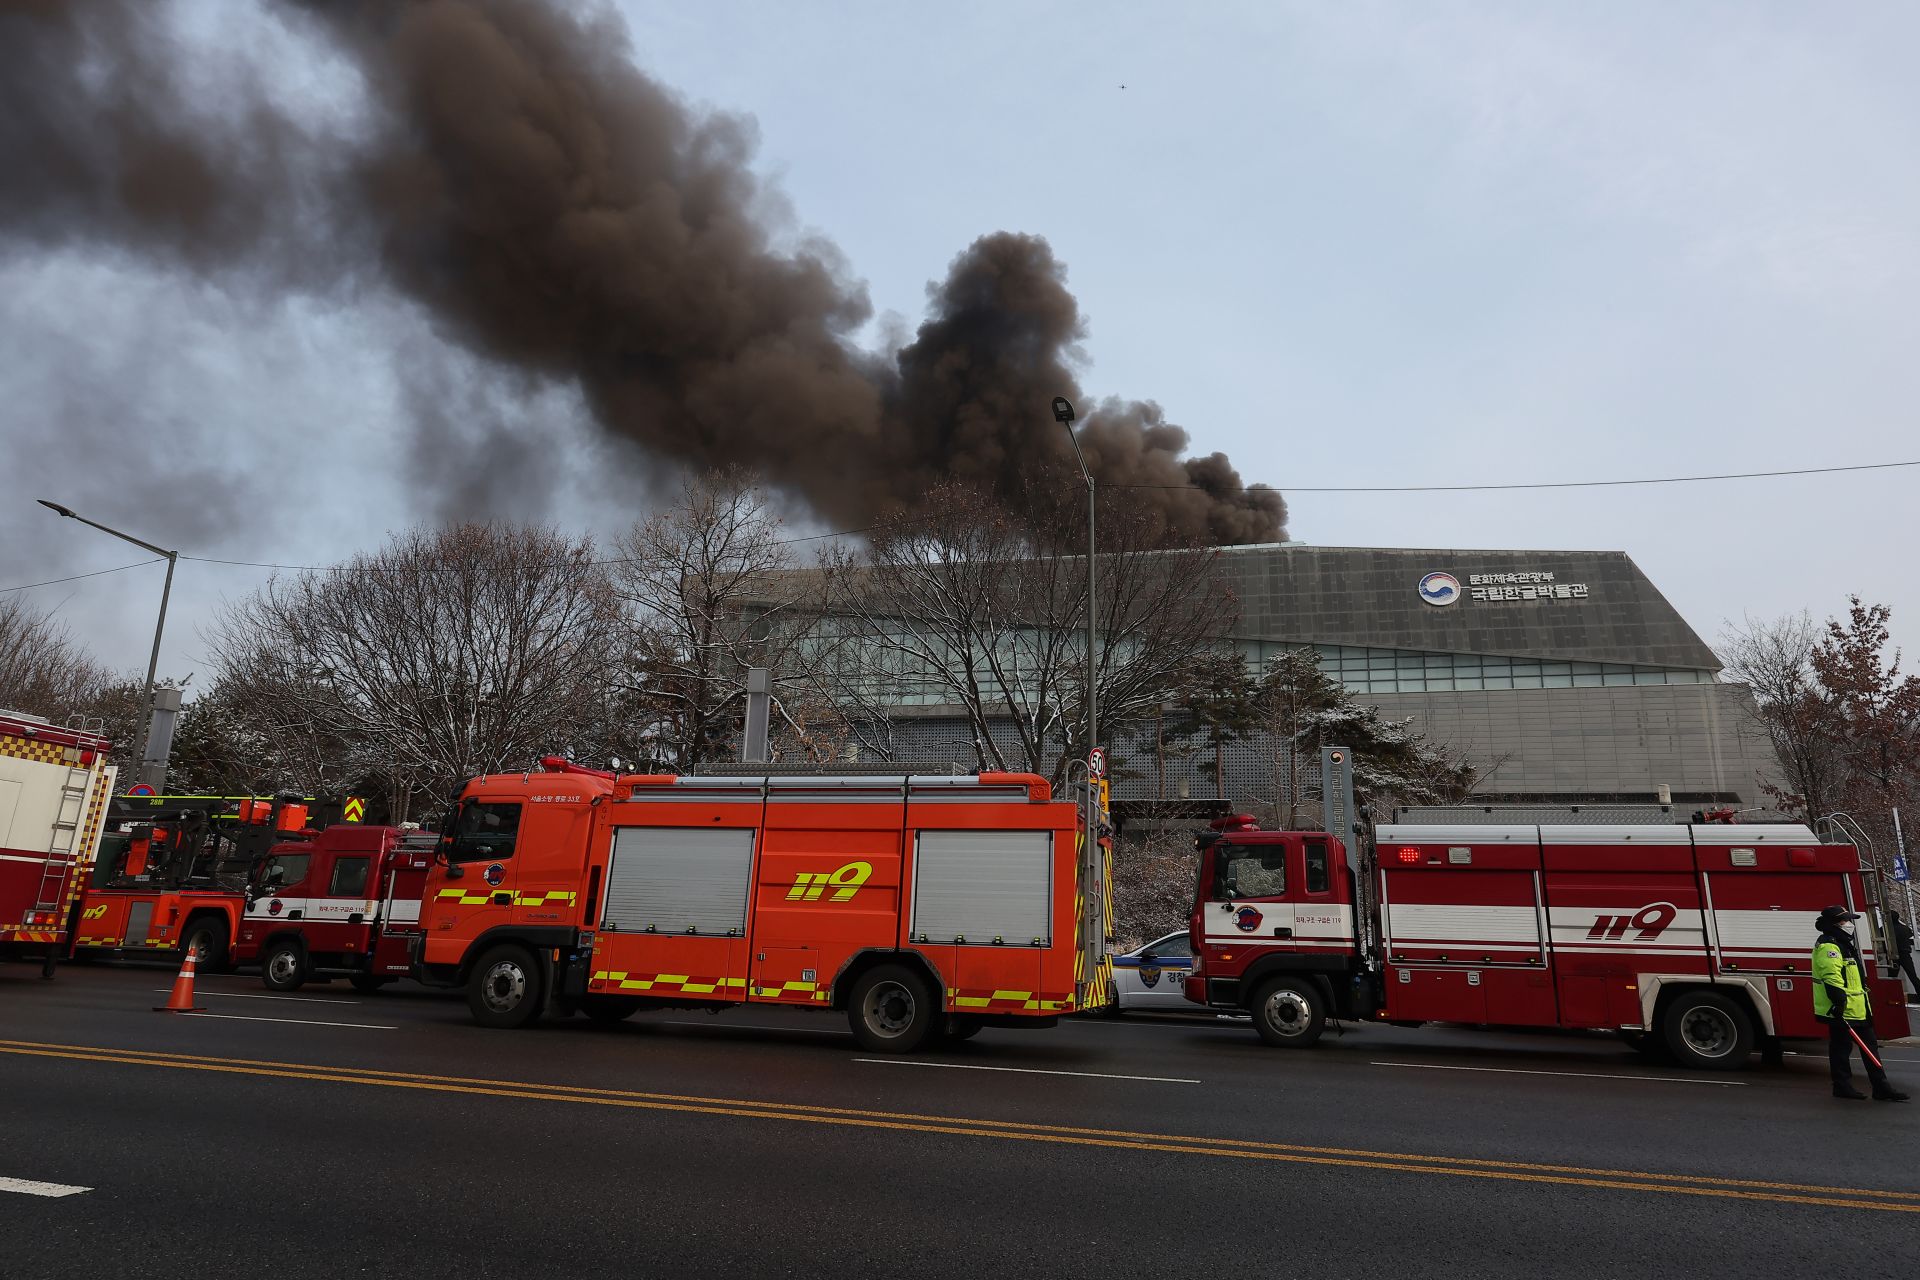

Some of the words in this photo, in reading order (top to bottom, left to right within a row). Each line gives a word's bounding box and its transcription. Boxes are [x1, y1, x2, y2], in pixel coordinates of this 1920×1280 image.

[1469, 571, 1554, 586] 문화체육관광부
[1471, 584, 1589, 602] 국립한글박물관
[1092, 754, 1103, 773] 50
[784, 861, 873, 902] 119
[82, 904, 108, 919] 119
[1586, 903, 1677, 941] 119
